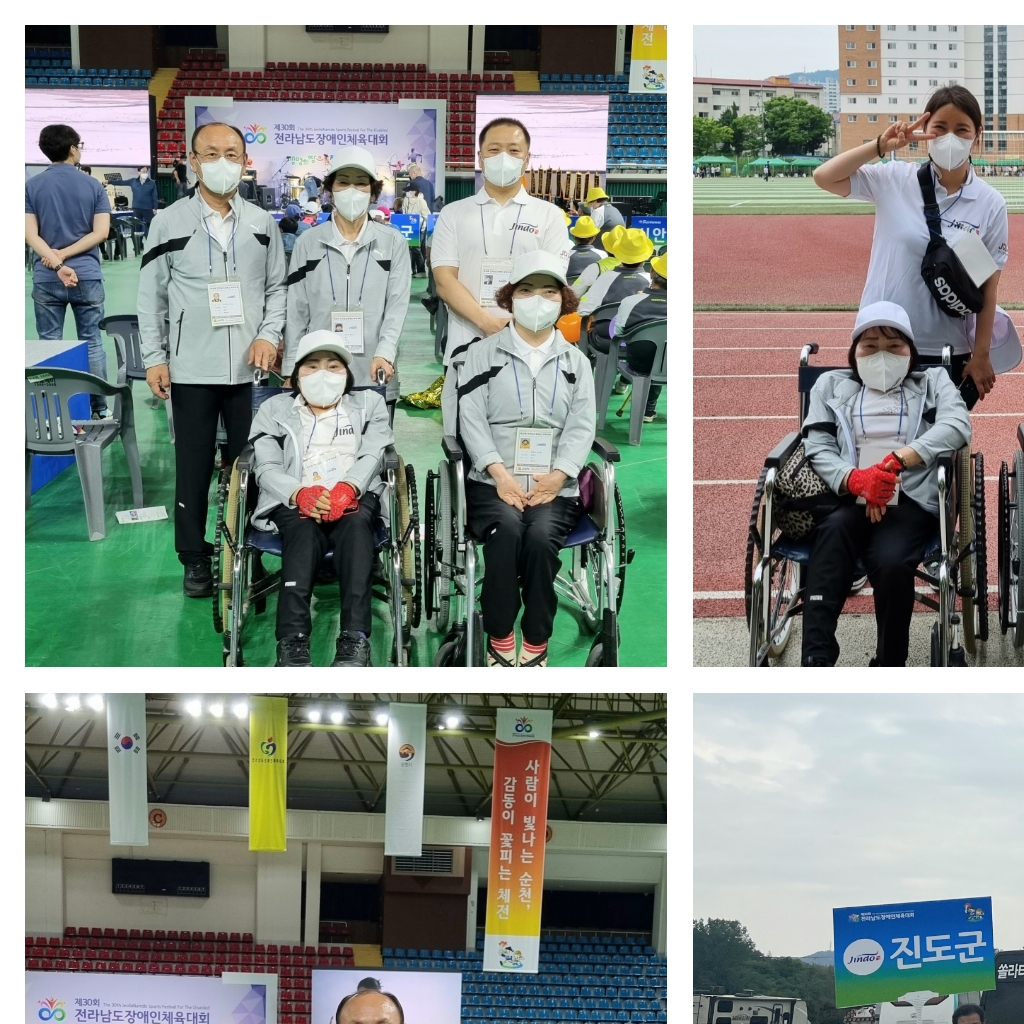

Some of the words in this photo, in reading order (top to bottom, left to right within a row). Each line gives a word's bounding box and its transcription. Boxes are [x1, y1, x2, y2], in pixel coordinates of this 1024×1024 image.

[274, 123, 295, 131] 제30회
[274, 133, 389, 146] 전라남도장애인체육대회
[501, 776, 518, 825] 감동이
[524, 759, 540, 808] 사람이
[497, 832, 514, 881] 꽃피는
[519, 815, 536, 864] 빛나는
[496, 888, 511, 920] 체전
[847, 955, 875, 965] Jindo
[890, 930, 987, 970] 진도군
[75, 998, 100, 1008] 제30회
[75, 1008, 210, 1024] 전라남도장애인체육대회
